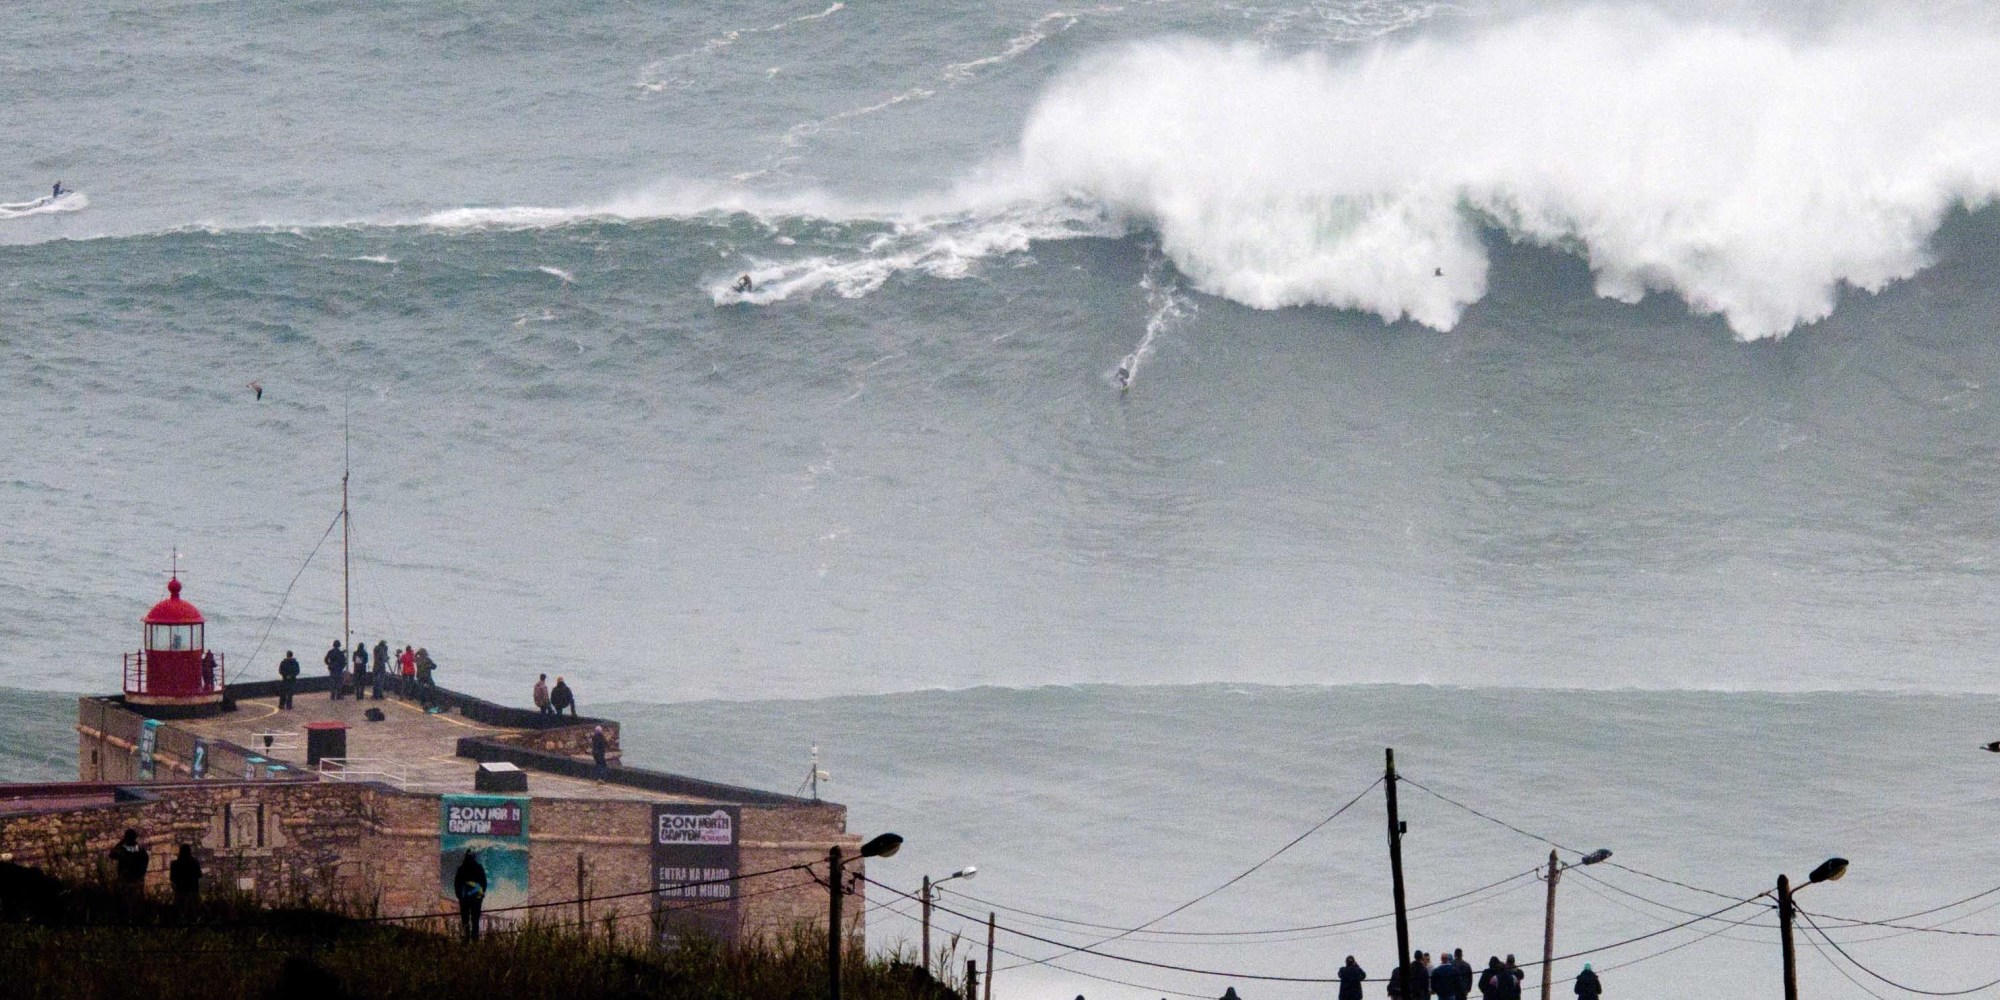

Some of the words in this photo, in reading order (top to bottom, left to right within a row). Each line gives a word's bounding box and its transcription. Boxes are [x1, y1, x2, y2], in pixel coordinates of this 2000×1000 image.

[450, 807, 486, 820] ZON
[449, 820, 491, 833] CANYON
[662, 816, 696, 829] ZON
[661, 829, 701, 841] CANYON
[660, 867, 686, 881] ENTRA
[689, 868, 700, 881] NA
[703, 868, 730, 881] MAIOR
[685, 885, 697, 897] DO
[700, 885, 731, 898] MUNDO
